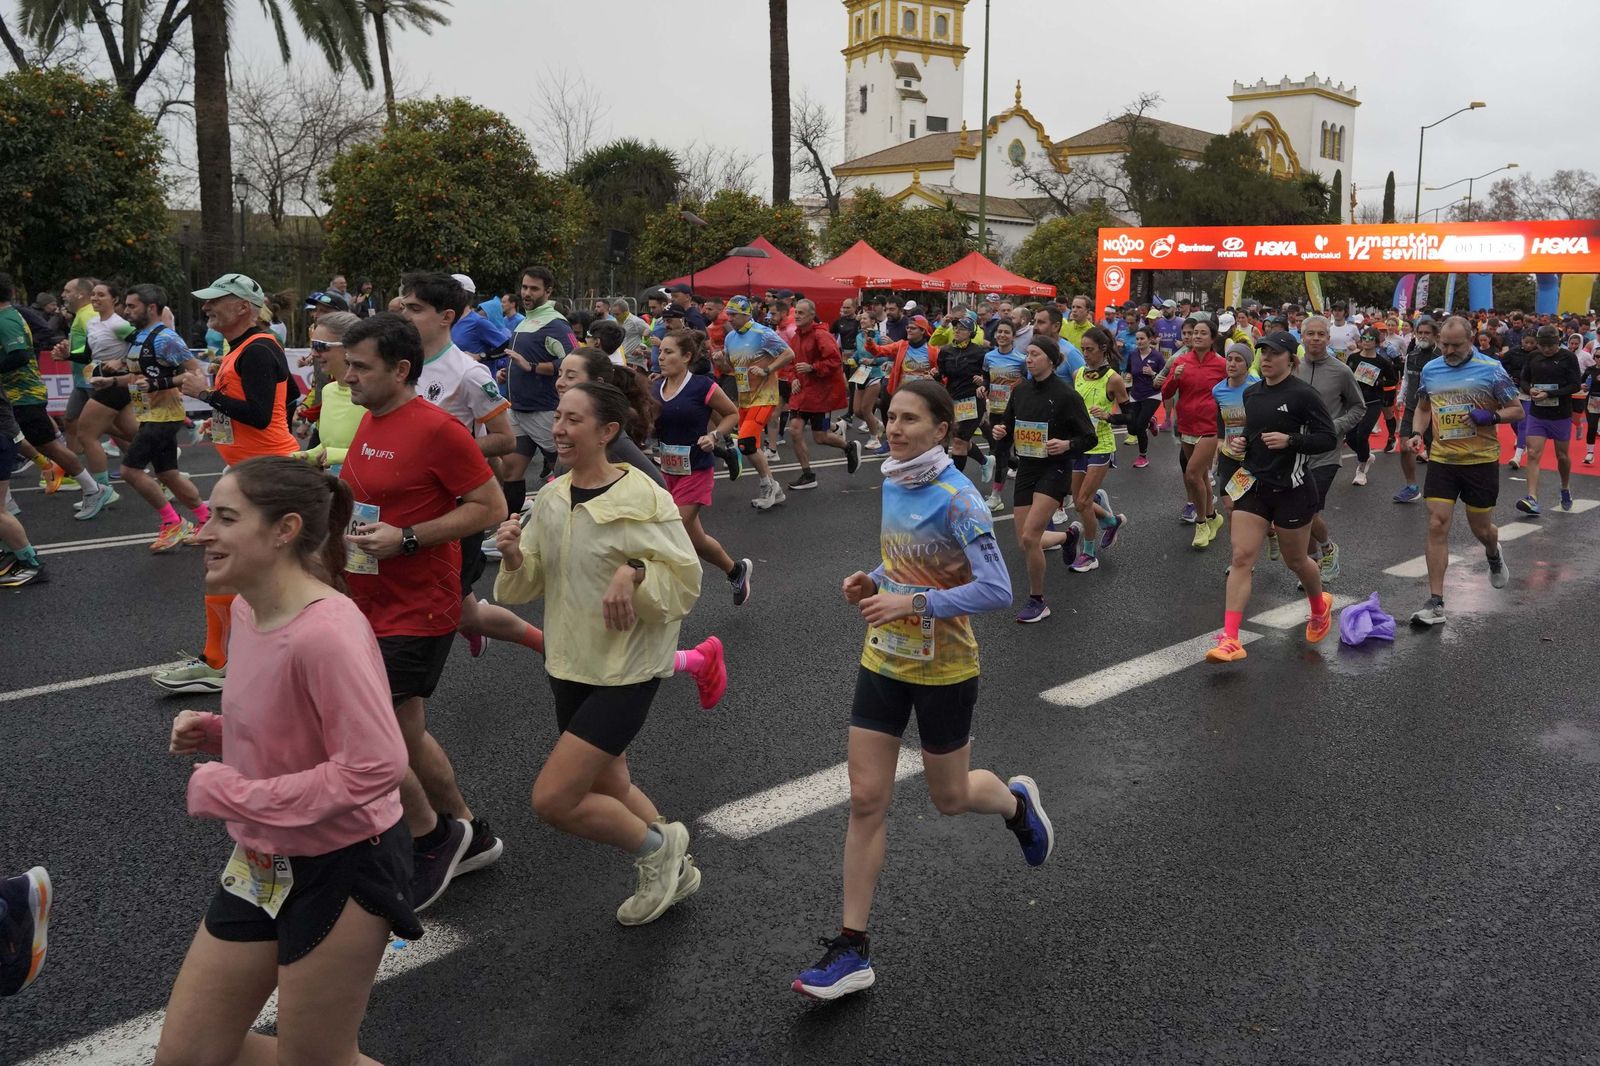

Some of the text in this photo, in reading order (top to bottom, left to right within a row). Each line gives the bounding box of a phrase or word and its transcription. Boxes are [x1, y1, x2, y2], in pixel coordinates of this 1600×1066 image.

[1367, 232, 1439, 248] maratón
[1531, 236, 1590, 254] HOKA
[1178, 243, 1215, 253] Sprinter
[1254, 240, 1298, 256] HOKA
[1382, 245, 1440, 260] sevilla
[1015, 429, 1042, 443] 15432
[375, 449, 395, 460] LIFTS
